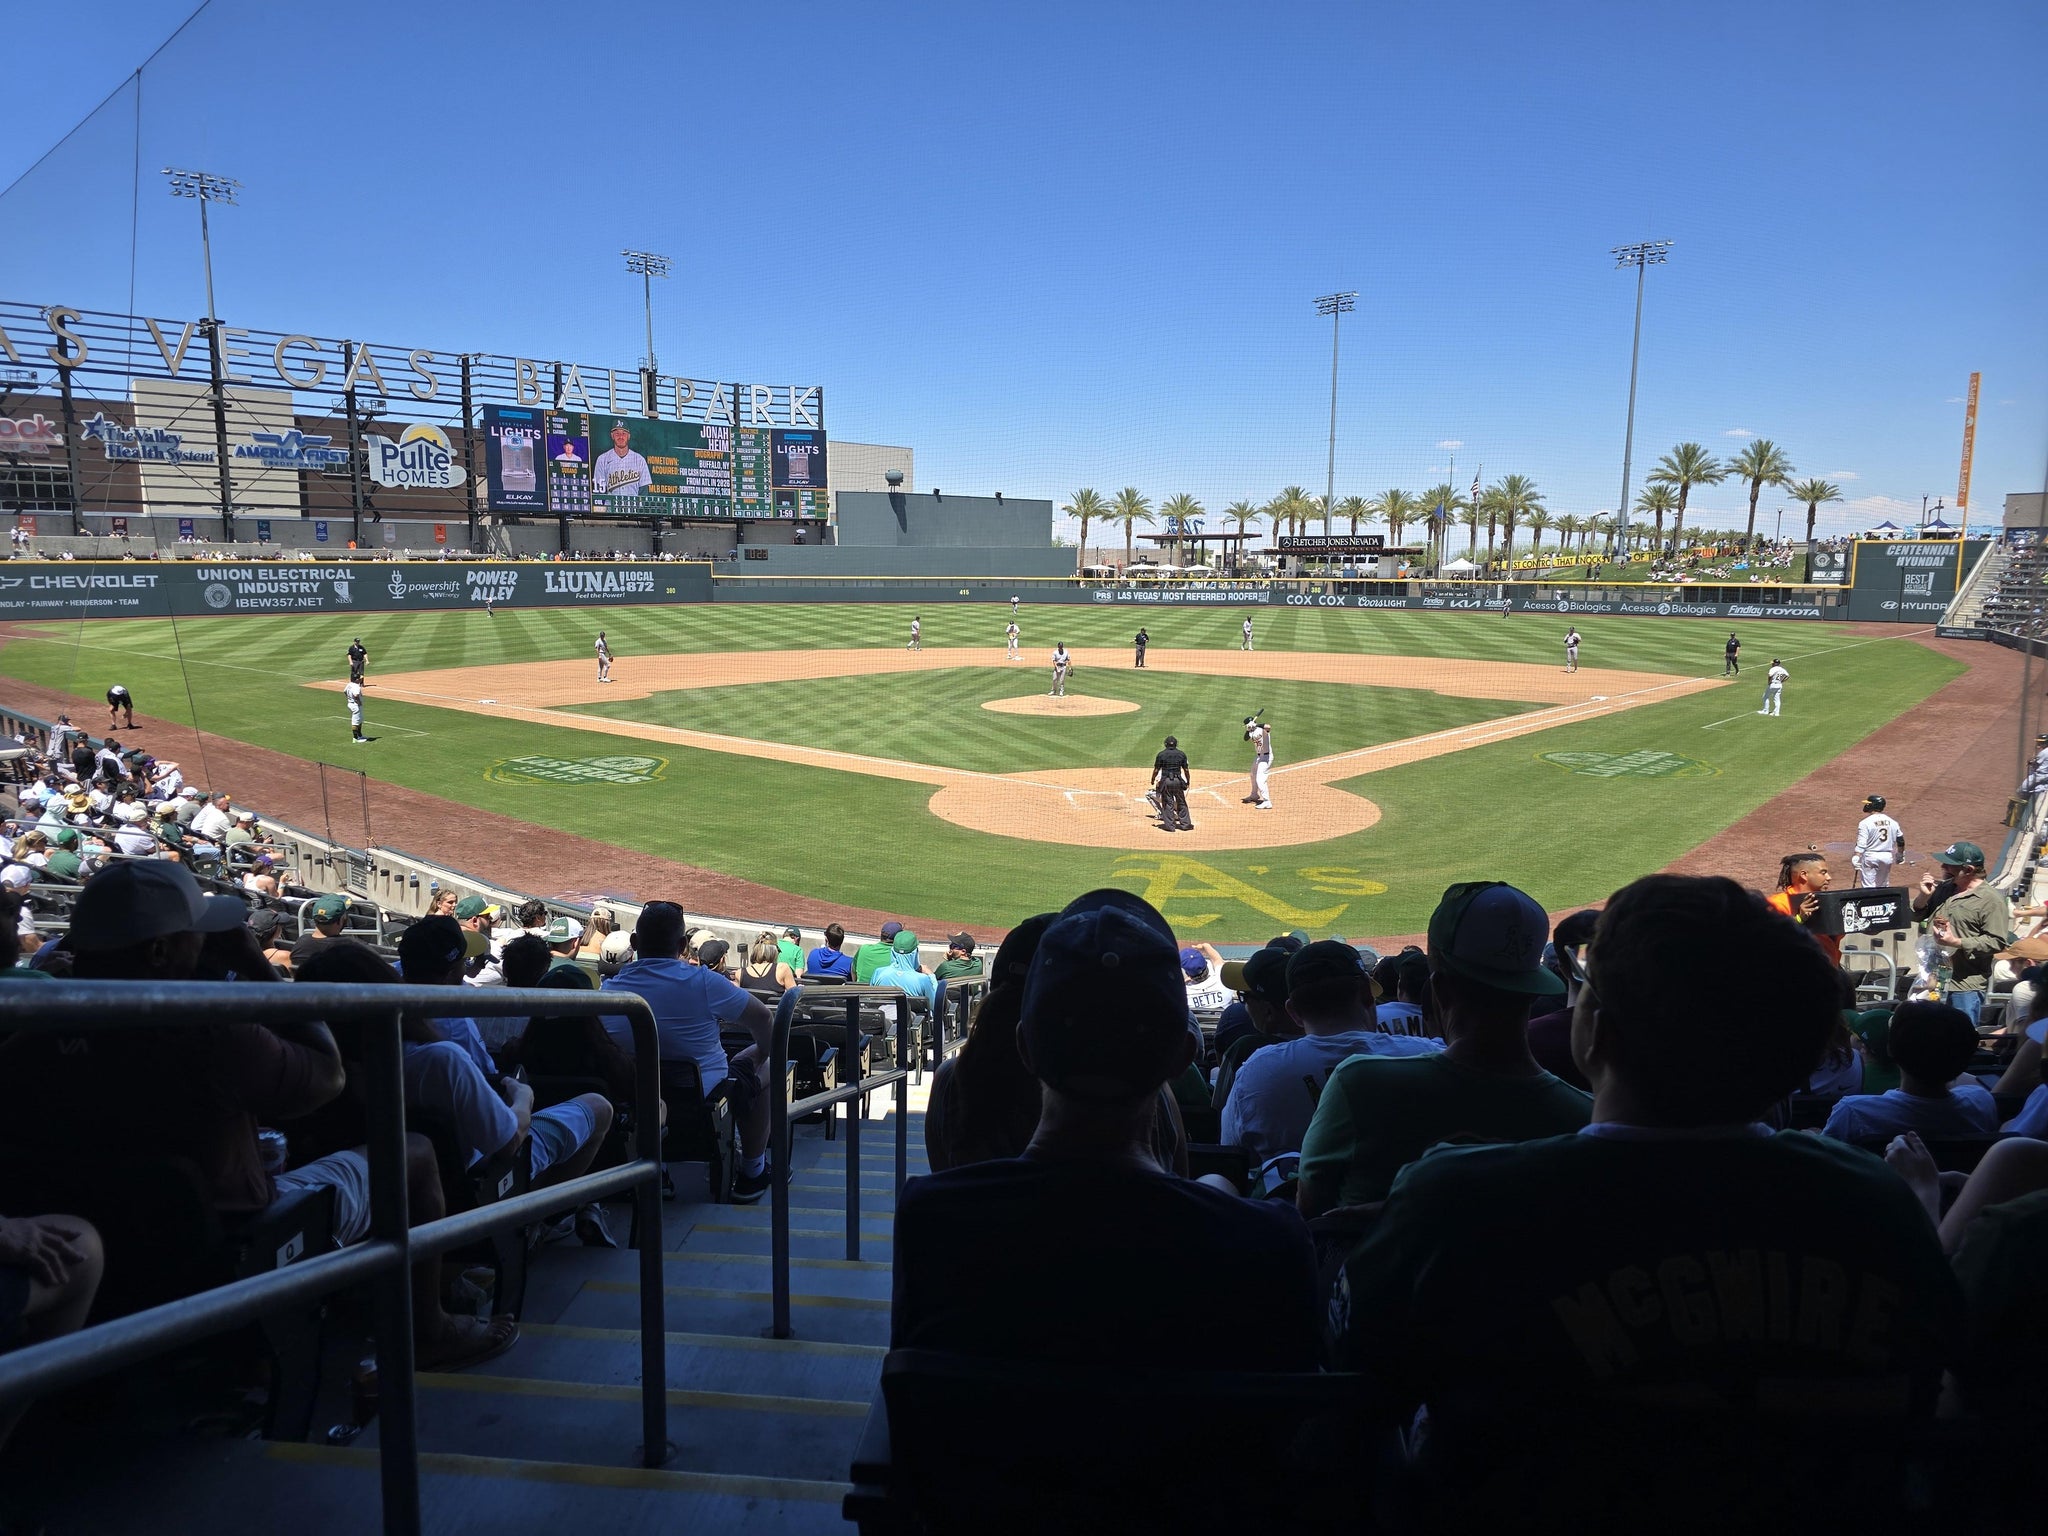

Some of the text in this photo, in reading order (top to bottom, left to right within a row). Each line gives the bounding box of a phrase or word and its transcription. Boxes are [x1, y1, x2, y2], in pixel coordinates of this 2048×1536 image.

[144, 318, 439, 399] VEGAS
[515, 358, 818, 426] BALLPARK
[105, 427, 183, 448] The Valley
[490, 426, 541, 440] LIGHTS
[700, 425, 729, 440] JONAH
[708, 439, 729, 452] HEIM
[777, 445, 819, 455] LIGHTS
[108, 443, 215, 464] Health System
[235, 445, 349, 464] AMERICA FIRST
[381, 442, 450, 471] Pulte
[694, 450, 723, 459] BIOGRAPHY
[647, 456, 679, 466] HOMETOWN:
[699, 460, 722, 470] BUFFALO,
[652, 466, 679, 475] ACQUIRED:
[383, 469, 450, 485] HOMES
[687, 477, 701, 486] FROM
[701, 478, 710, 486] ATL
[592, 478, 607, 494] 15
[648, 484, 660, 493] MLB
[661, 485, 680, 494] DEBUT:
[779, 509, 793, 518] 1:59
[1292, 537, 1379, 547] FLETCHER JONES NEVADA
[1886, 544, 1956, 556] CENTENNIAL
[1557, 557, 1573, 566] THAT
[1633, 553, 1645, 561] OF
[1896, 557, 1945, 567] HYUNDAI
[197, 568, 355, 581] UNION ELECTRICAL
[466, 570, 519, 585] POWER
[625, 571, 654, 581] LOCAL
[1905, 574, 1928, 584] BEST
[30, 575, 158, 589] CHEVROLET
[409, 581, 460, 592] powershift
[544, 570, 625, 593] LiUNA!
[626, 582, 655, 592] 872
[238, 582, 320, 594] INDUSTRY
[471, 586, 515, 602] ALLEY
[1096, 592, 1112, 600] PRS
[1117, 591, 1131, 600] LAS
[1133, 591, 1160, 600] VEGAS'
[1162, 592, 1184, 600] MOST
[1186, 592, 1226, 601] REFERRED
[1228, 592, 1258, 601] ROOFER
[1286, 594, 1312, 605] COX
[1318, 595, 1345, 606] COX
[1358, 596, 1406, 608] Coors LIGHT
[70, 599, 113, 607] HENDERSON
[236, 597, 324, 608] IBEW357.NET
[1523, 601, 1611, 612] Acesso Biologics
[1620, 603, 1716, 614] Acesso Biologics
[1901, 602, 1949, 610] HYUNDA
[1728, 605, 1820, 617] Findlay TOYOTA
[1879, 828, 1888, 842] 3
[1192, 991, 1223, 1008] BETTS
